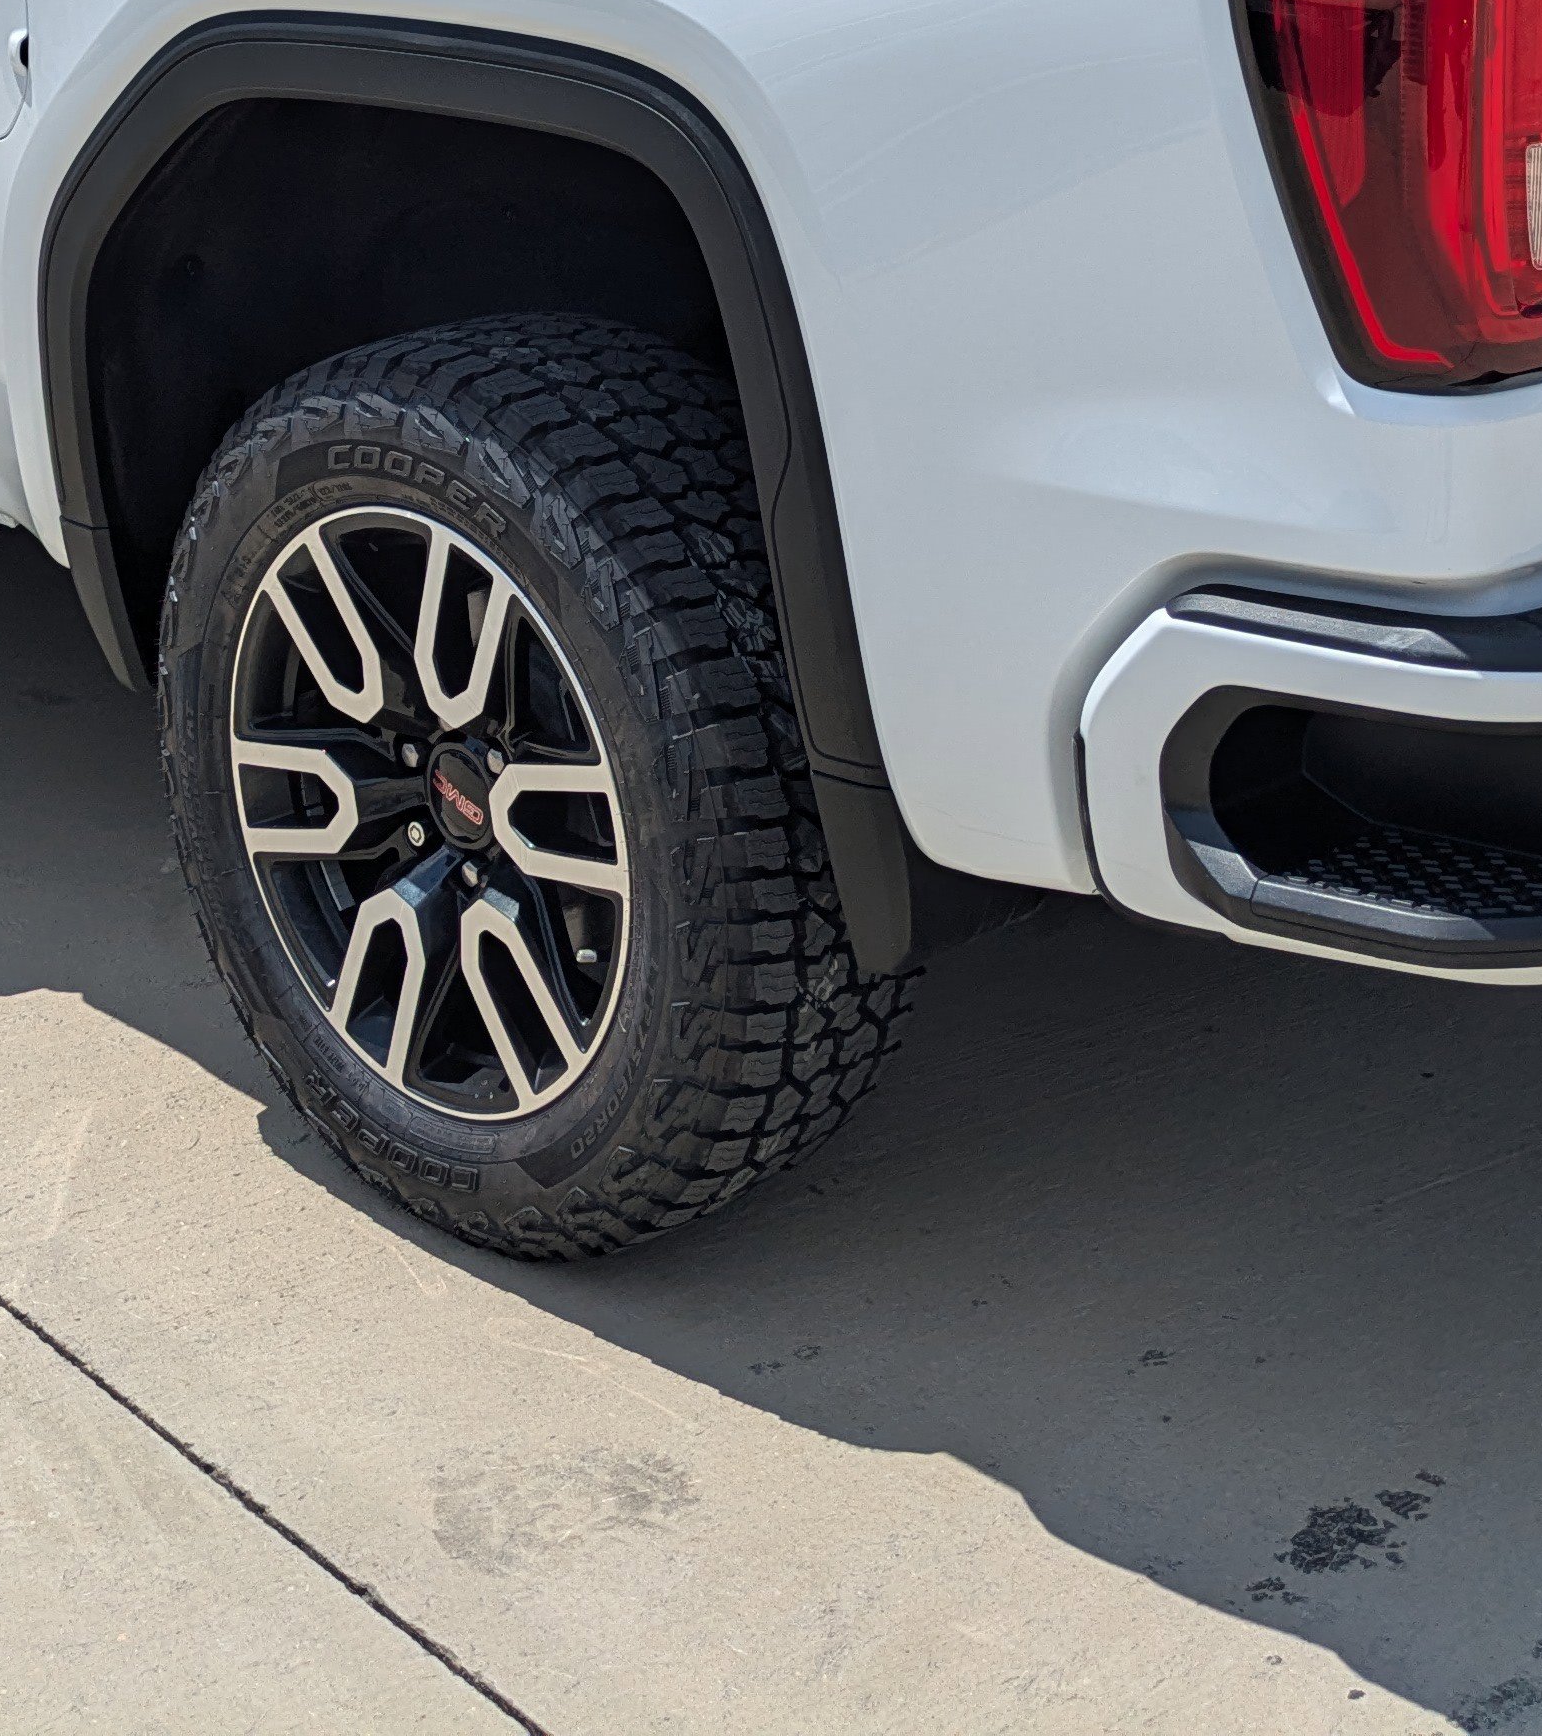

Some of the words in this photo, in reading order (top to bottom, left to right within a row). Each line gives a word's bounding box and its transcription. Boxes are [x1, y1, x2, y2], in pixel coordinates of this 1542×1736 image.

[327, 445, 507, 541] COOPER
[432, 768, 484, 826] GMC
[302, 1063, 480, 1192] COOPER
